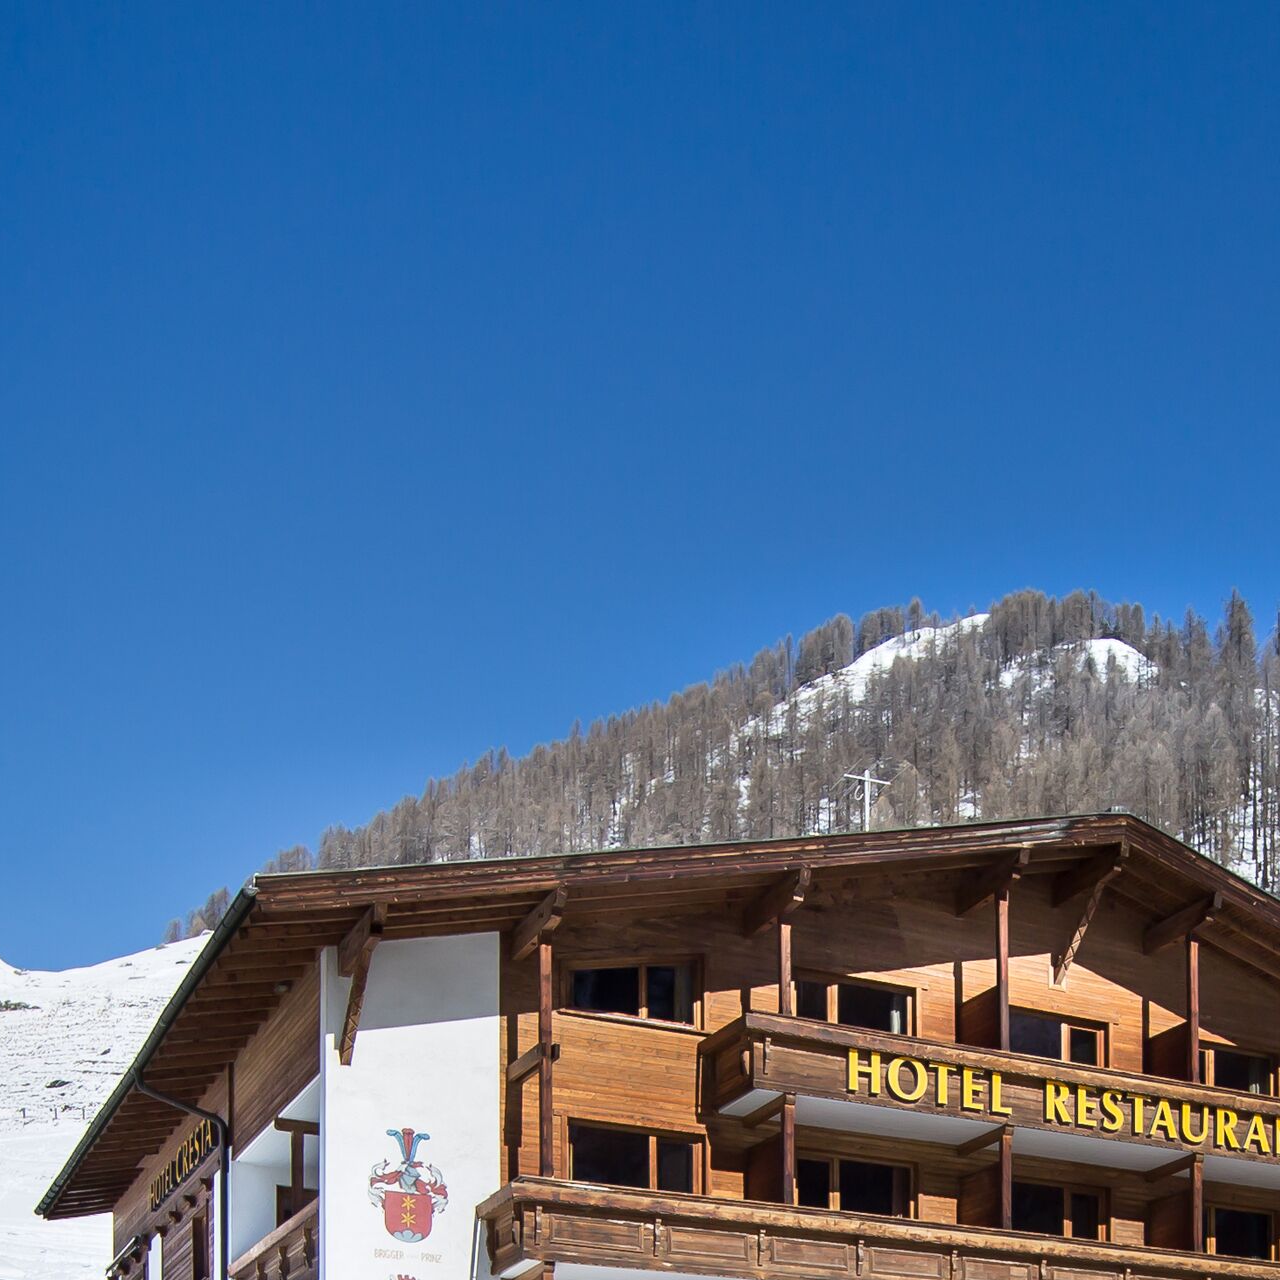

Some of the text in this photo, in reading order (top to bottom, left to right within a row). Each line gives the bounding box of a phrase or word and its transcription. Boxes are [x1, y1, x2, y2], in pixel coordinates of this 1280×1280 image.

[848, 1048, 1013, 1116] HOTEL
[150, 1118, 212, 1211] HOTEL CRESTA
